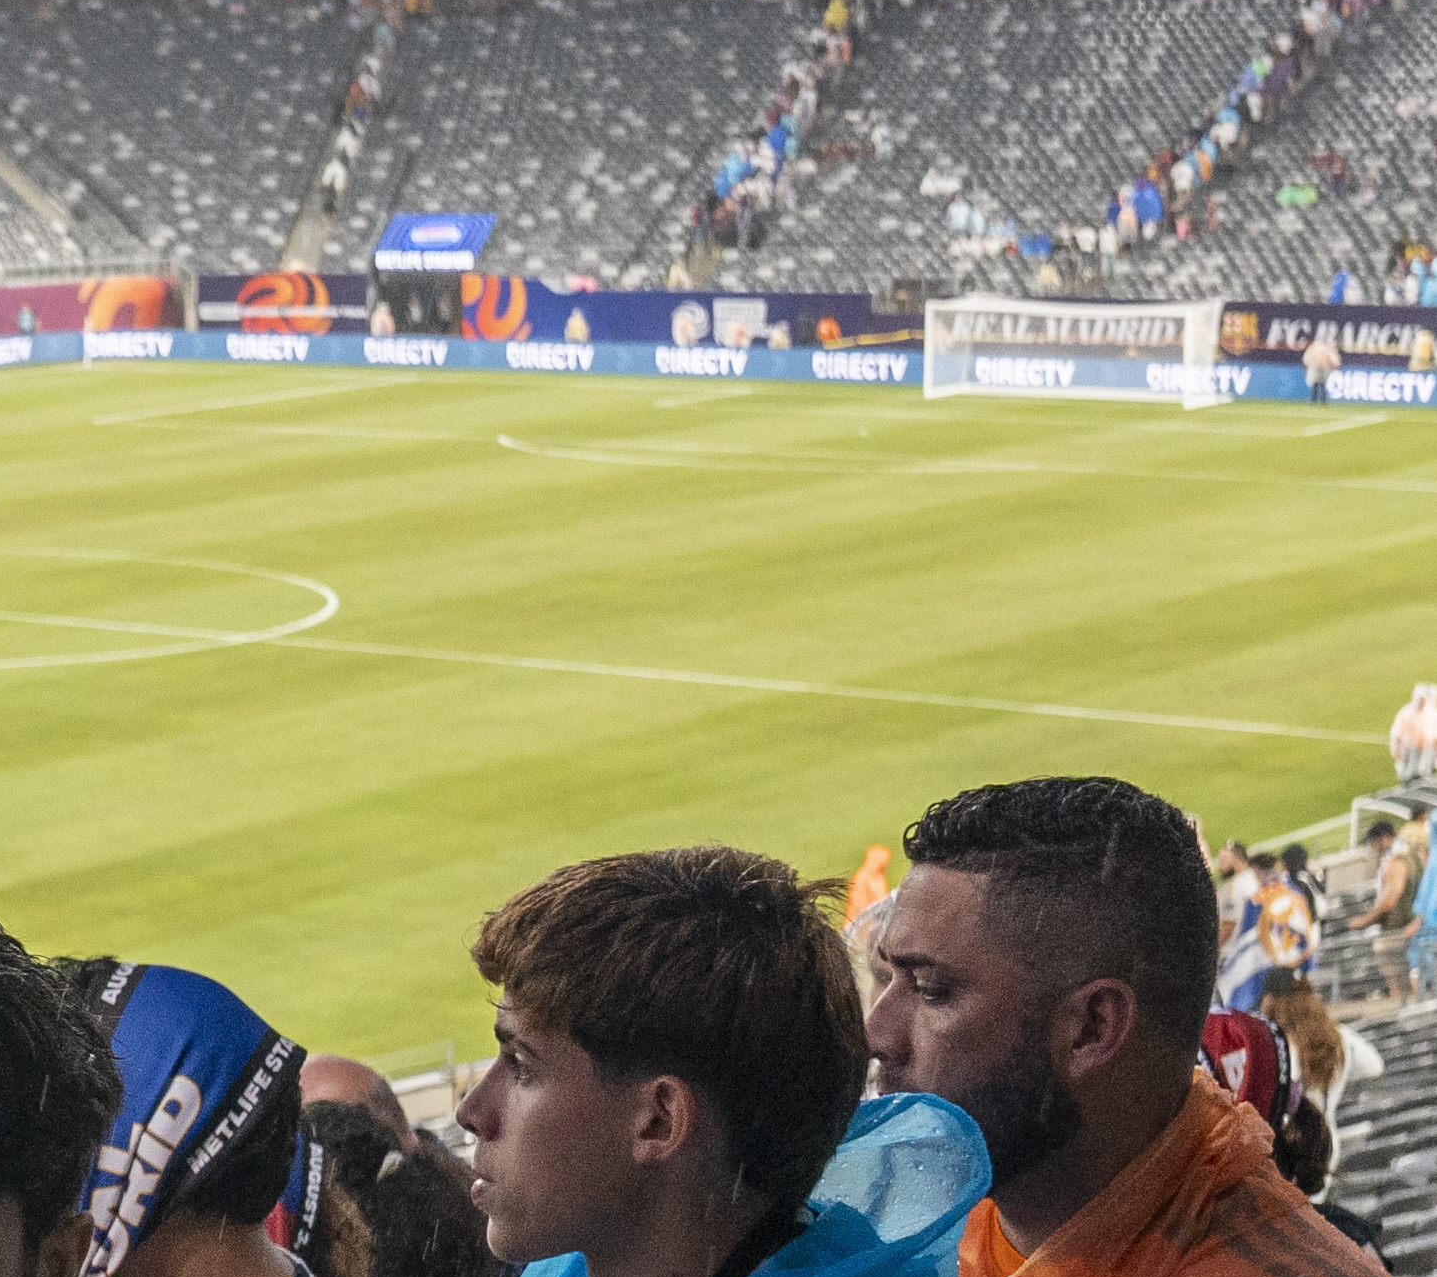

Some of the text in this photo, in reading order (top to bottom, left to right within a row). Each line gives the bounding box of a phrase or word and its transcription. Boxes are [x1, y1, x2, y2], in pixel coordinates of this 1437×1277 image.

[1046, 313, 1179, 344] MADRID
[1266, 315, 1312, 349] FC
[85, 331, 173, 358] DIRECTV
[226, 333, 309, 361] DIRECTV
[364, 339, 448, 366] DIRECTV
[506, 342, 594, 371] DIRECTV
[655, 346, 748, 376] DIRECTV
[812, 349, 908, 381] DIRECTV
[975, 357, 1076, 387] DIRECTV
[1145, 363, 1251, 395] DIRECTV
[1326, 369, 1435, 403] DIRECTV
[188, 1067, 274, 1175] METLIFE
